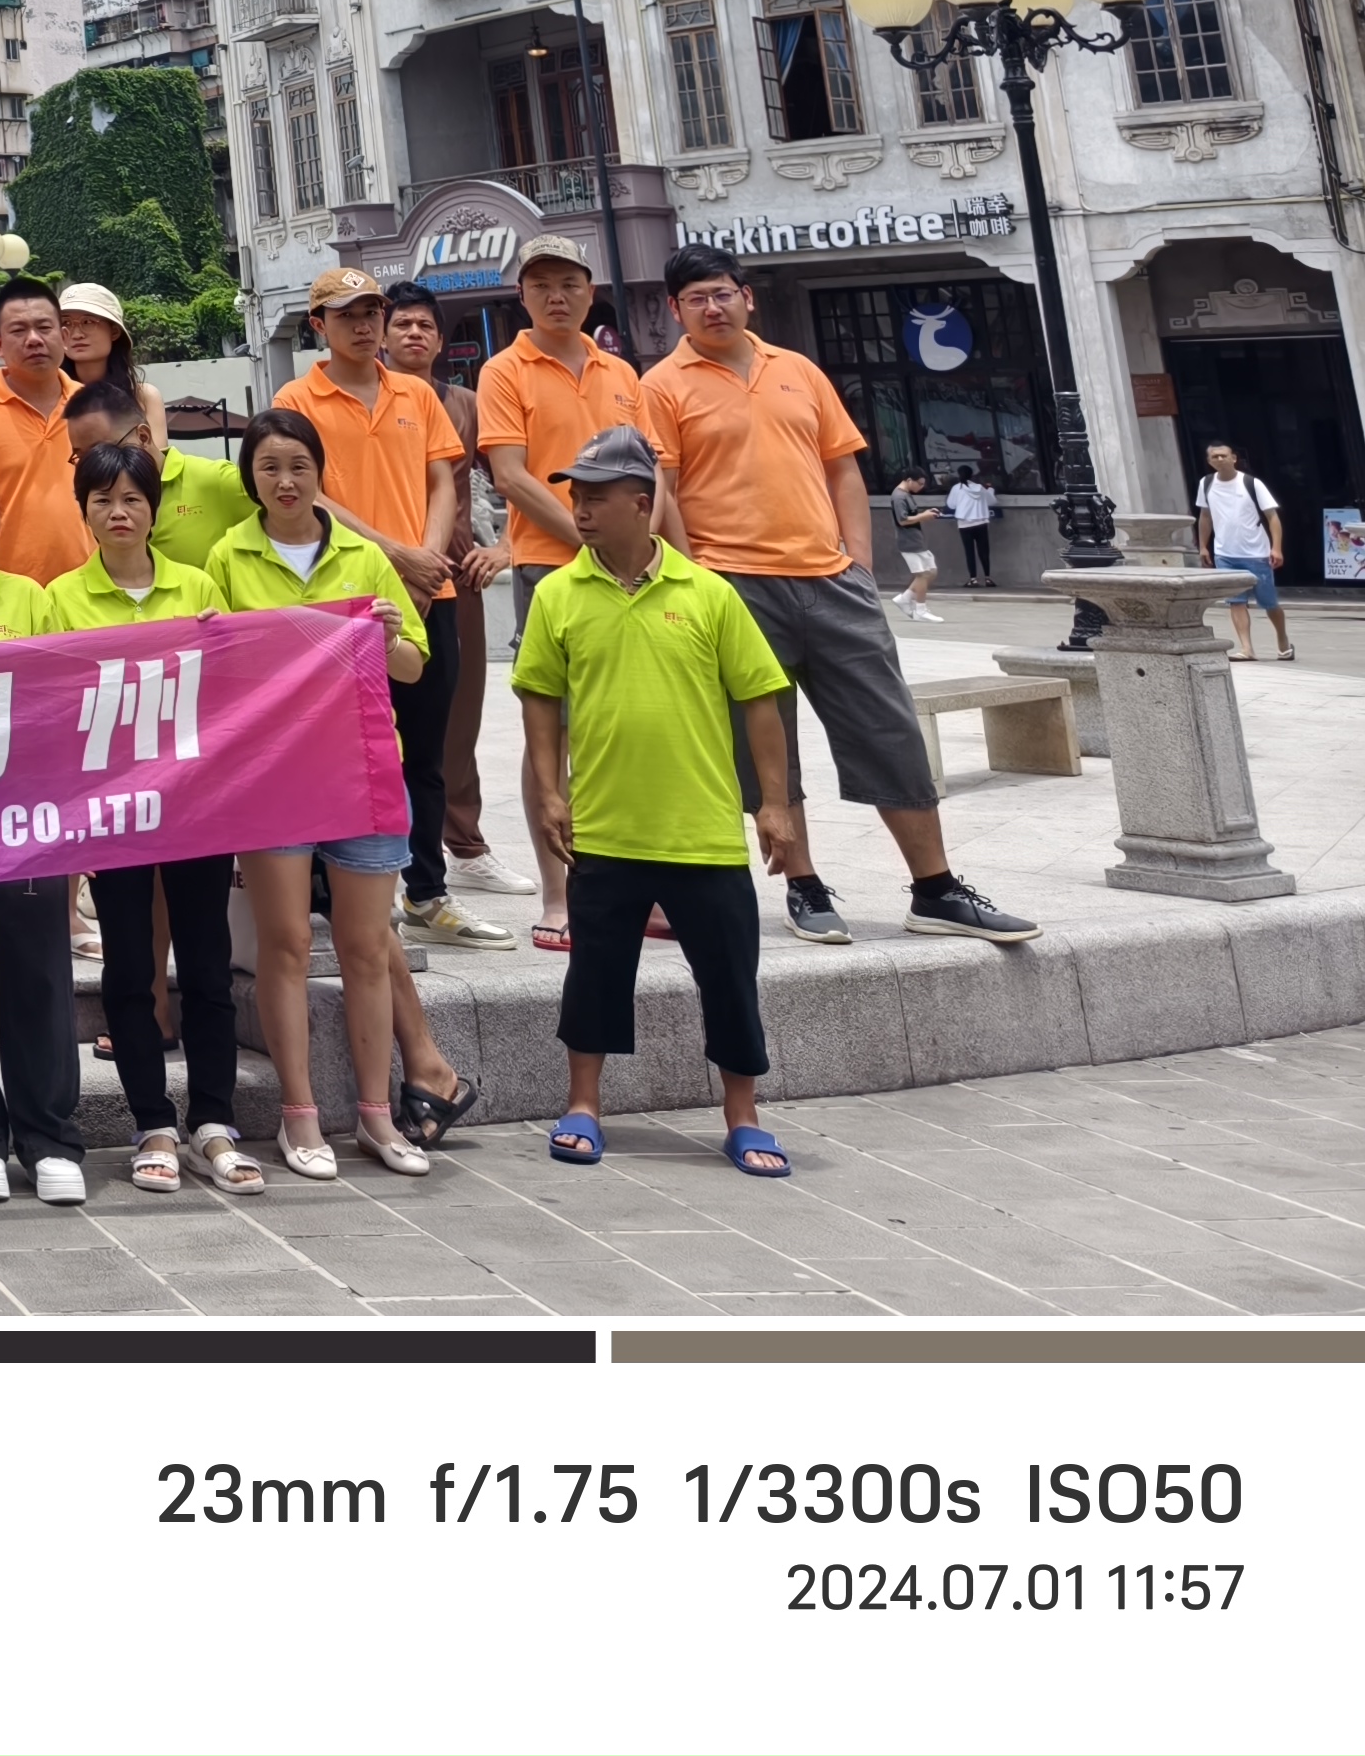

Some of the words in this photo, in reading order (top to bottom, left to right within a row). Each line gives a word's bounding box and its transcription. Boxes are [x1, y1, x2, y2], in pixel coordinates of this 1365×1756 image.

[966, 194, 1009, 216] 瑞幸
[675, 215, 800, 256] luckin
[808, 205, 946, 250] coffee
[968, 216, 1013, 238] 咖啡
[373, 262, 406, 278] GAME
[0, 789, 162, 848] CO.,LTD
